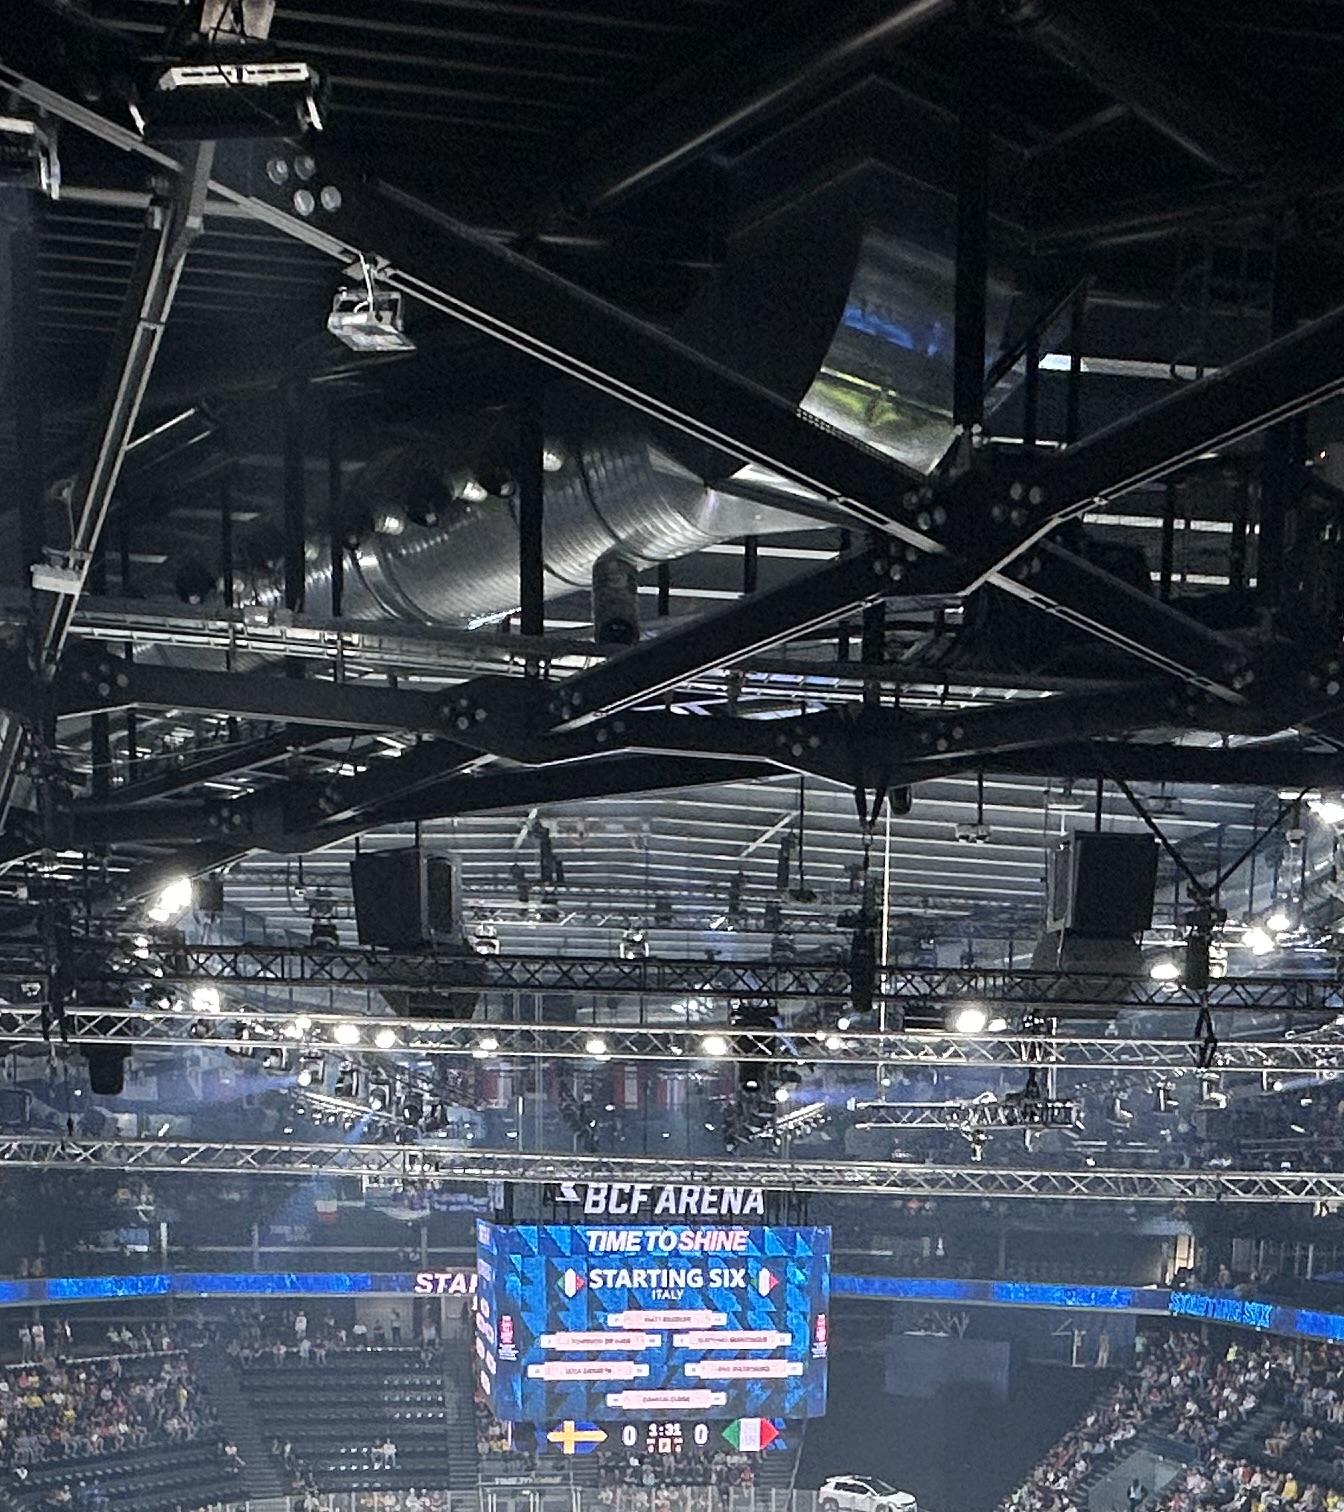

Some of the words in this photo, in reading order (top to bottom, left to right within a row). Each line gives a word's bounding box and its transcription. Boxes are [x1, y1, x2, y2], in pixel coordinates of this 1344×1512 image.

[584, 1183, 652, 1214] BCF
[654, 1184, 765, 1215] ARENA
[587, 1230, 643, 1252] TIME
[645, 1230, 677, 1252] TO
[678, 1230, 749, 1252] SHINE
[589, 1268, 704, 1289] STARTING
[709, 1268, 747, 1288] SIX
[651, 1289, 685, 1301] ITALY
[622, 1424, 638, 1447] 0
[694, 1423, 710, 1446] 0
